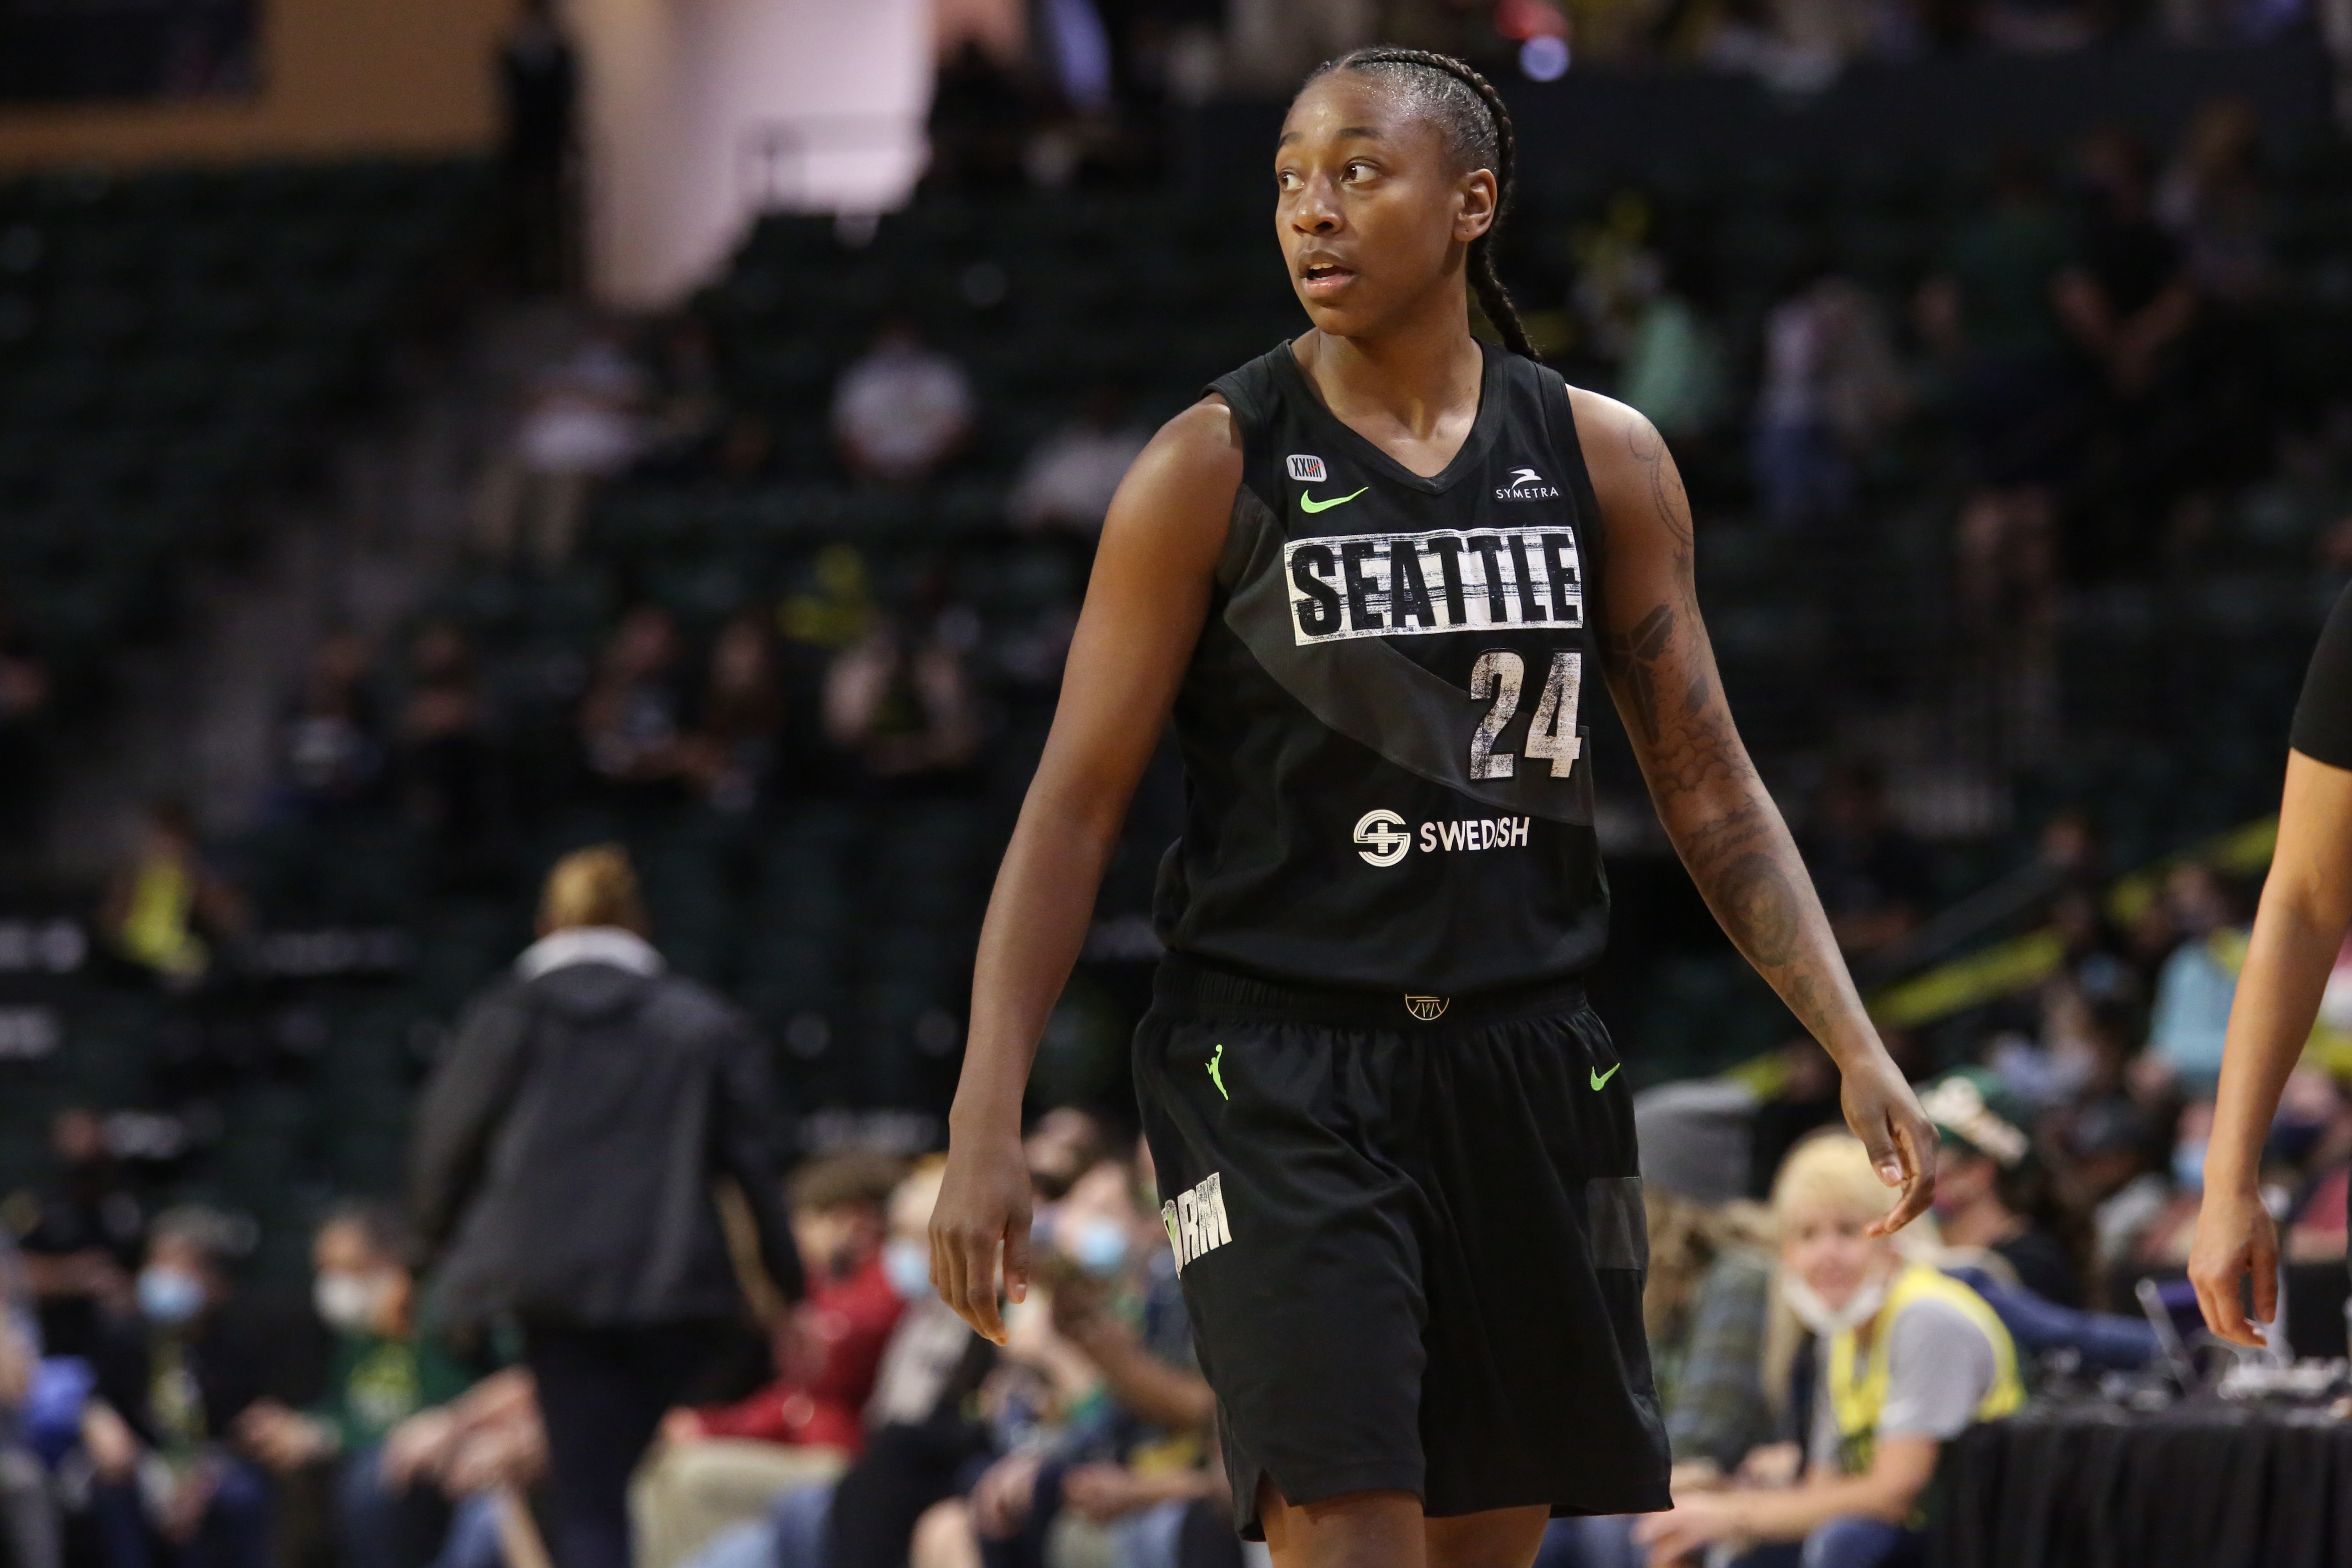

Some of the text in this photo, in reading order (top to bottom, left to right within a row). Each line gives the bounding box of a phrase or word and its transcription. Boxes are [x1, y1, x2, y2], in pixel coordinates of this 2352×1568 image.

[1496, 486, 1559, 499] SYMETRA
[1291, 533, 1579, 636] SEATTLE
[1470, 652, 1581, 780] 24
[1420, 817, 1530, 852] SWEDISH
